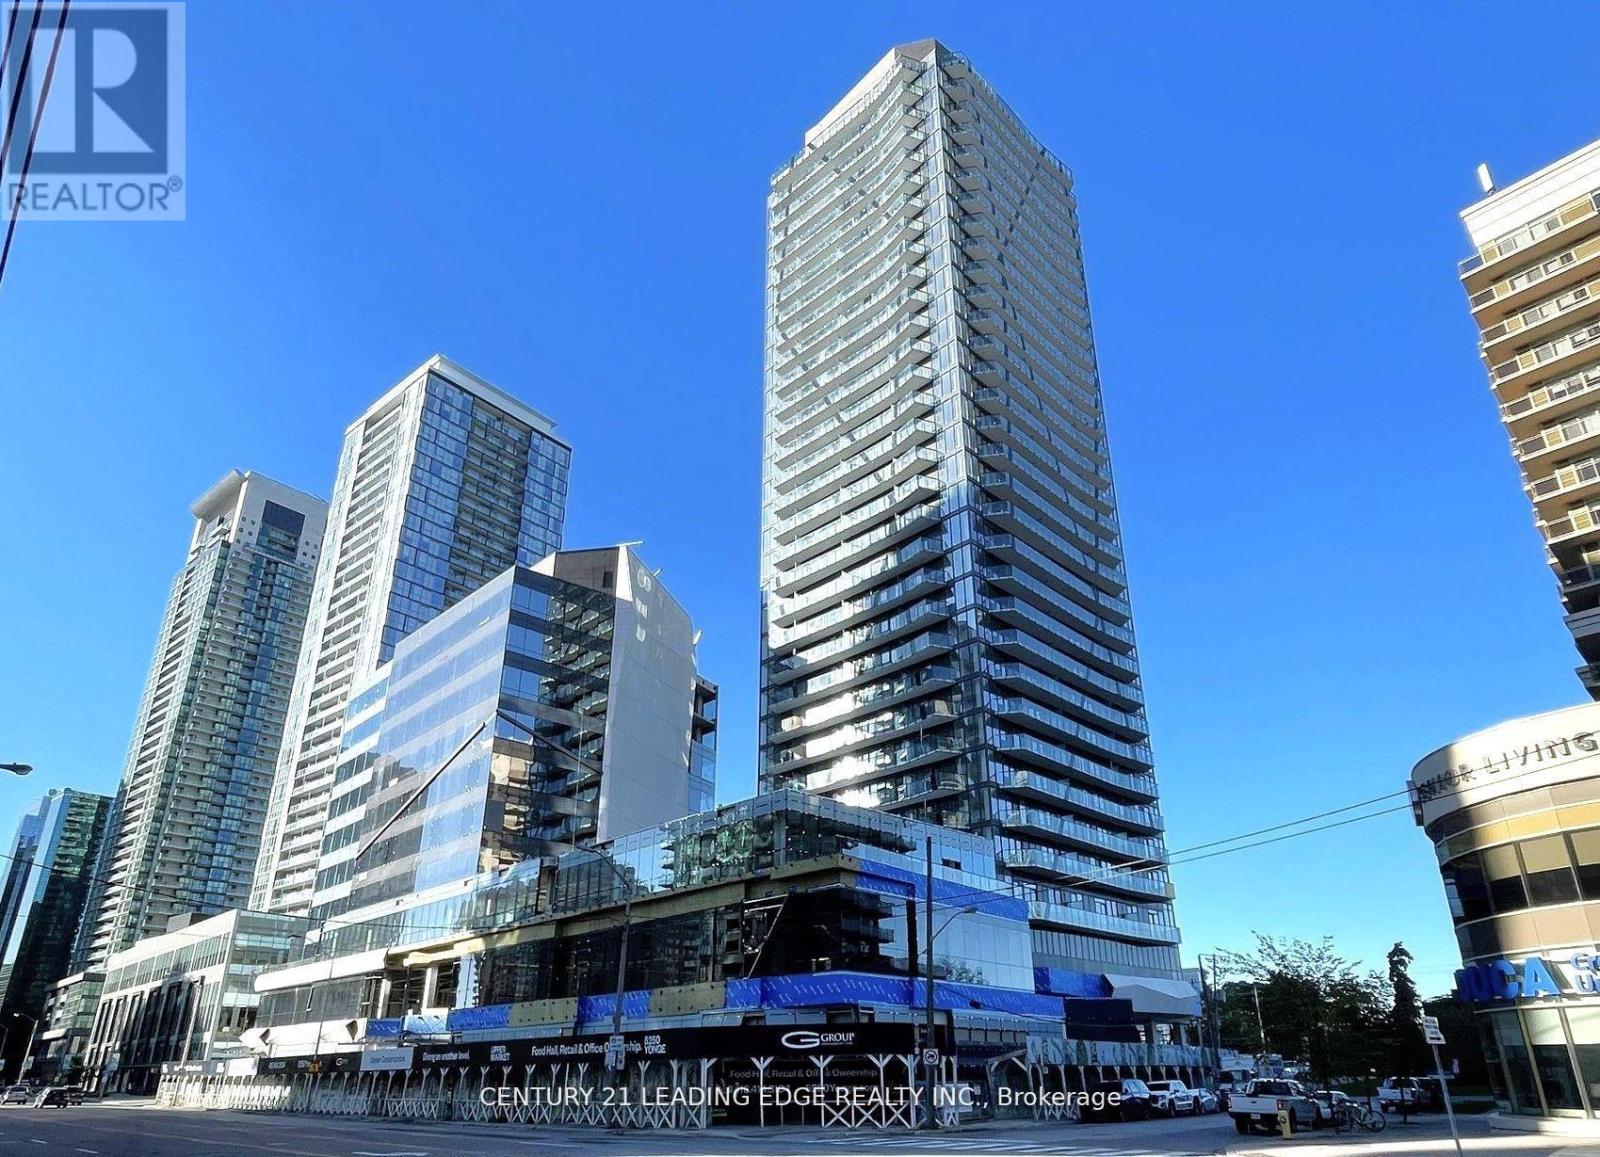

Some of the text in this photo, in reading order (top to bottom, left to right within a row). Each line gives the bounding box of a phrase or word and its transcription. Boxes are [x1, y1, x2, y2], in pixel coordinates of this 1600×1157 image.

[1483, 731, 1599, 775] LIVING
[820, 1032, 855, 1042] GROUP
[531, 1045, 546, 1056] Food
[559, 1043, 577, 1055] Retail
[578, 1043, 583, 1054] &
[583, 1042, 603, 1054] Office
[604, 1040, 642, 1054] Orship.
[644, 1044, 667, 1054] YONGE
[729, 1069, 752, 1078] Food
[797, 1069, 804, 1078] &
